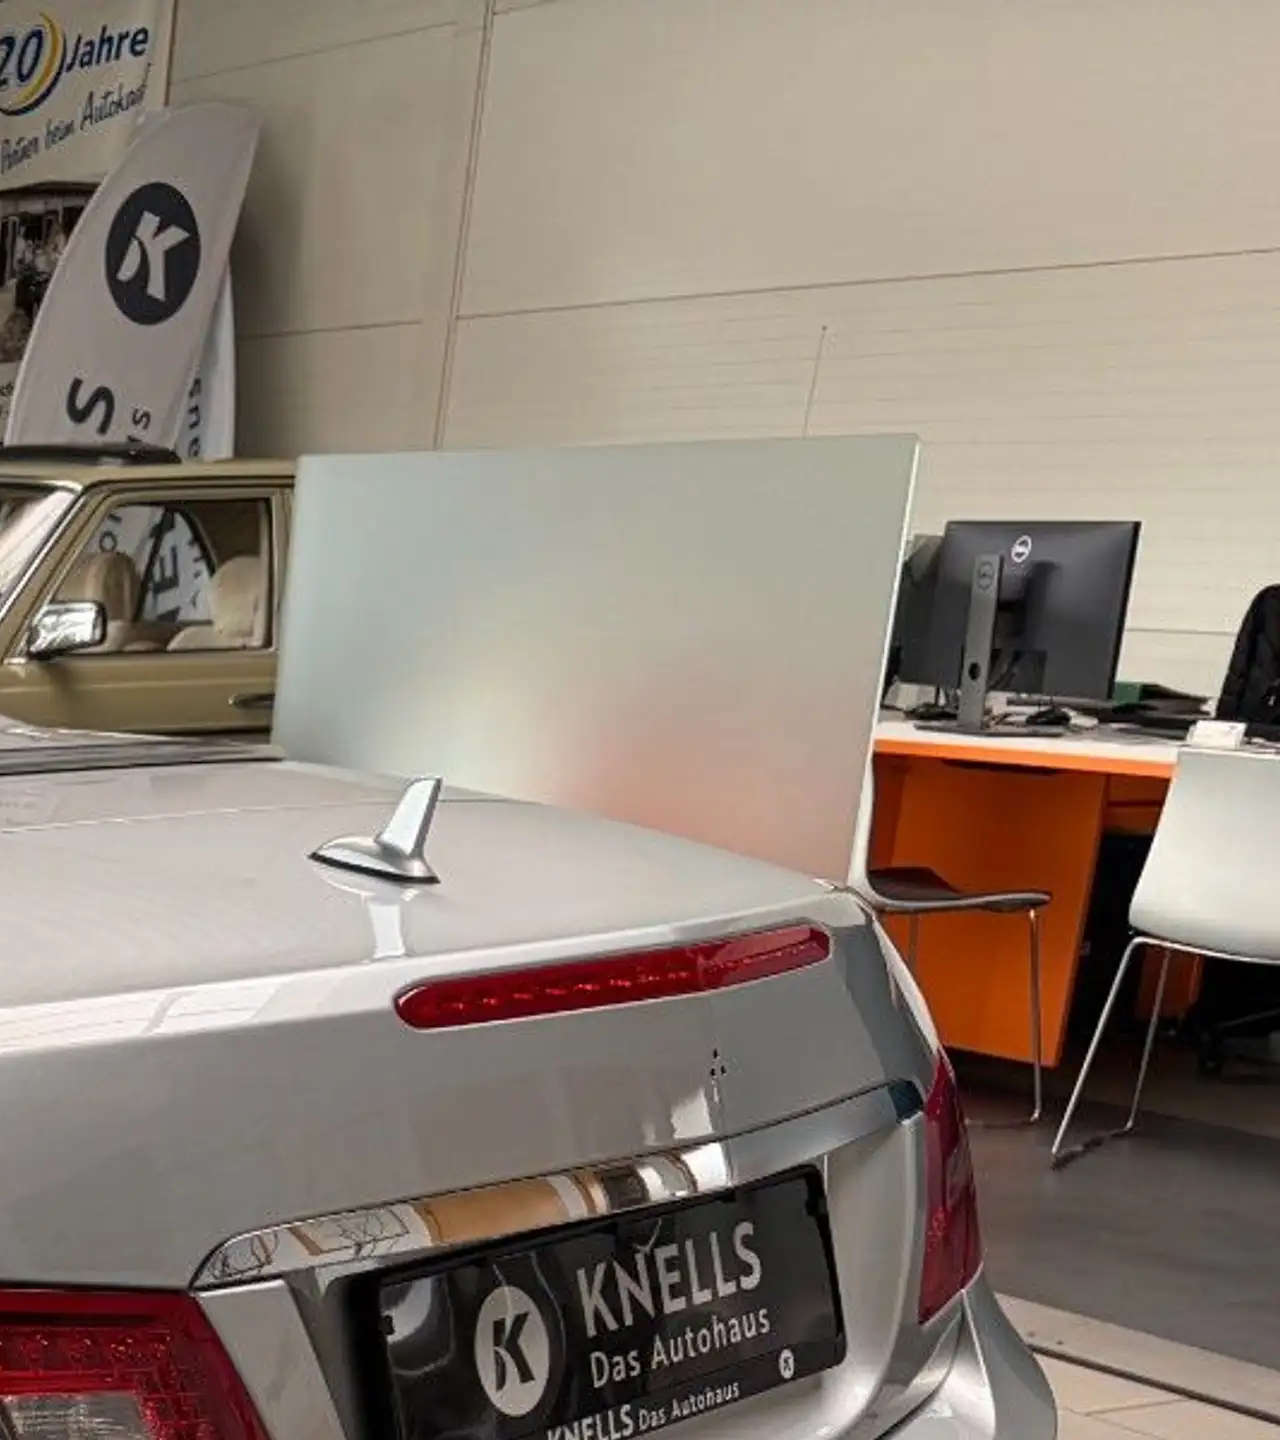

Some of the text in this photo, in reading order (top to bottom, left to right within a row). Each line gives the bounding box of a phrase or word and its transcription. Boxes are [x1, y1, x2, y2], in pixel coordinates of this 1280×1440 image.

[65, 24, 150, 72] Jahre
[576, 1221, 763, 1337] KNELLS
[591, 1306, 772, 1389] Das Autohaus
[638, 1406, 667, 1431] Das
[670, 1382, 740, 1419] Autohaus
